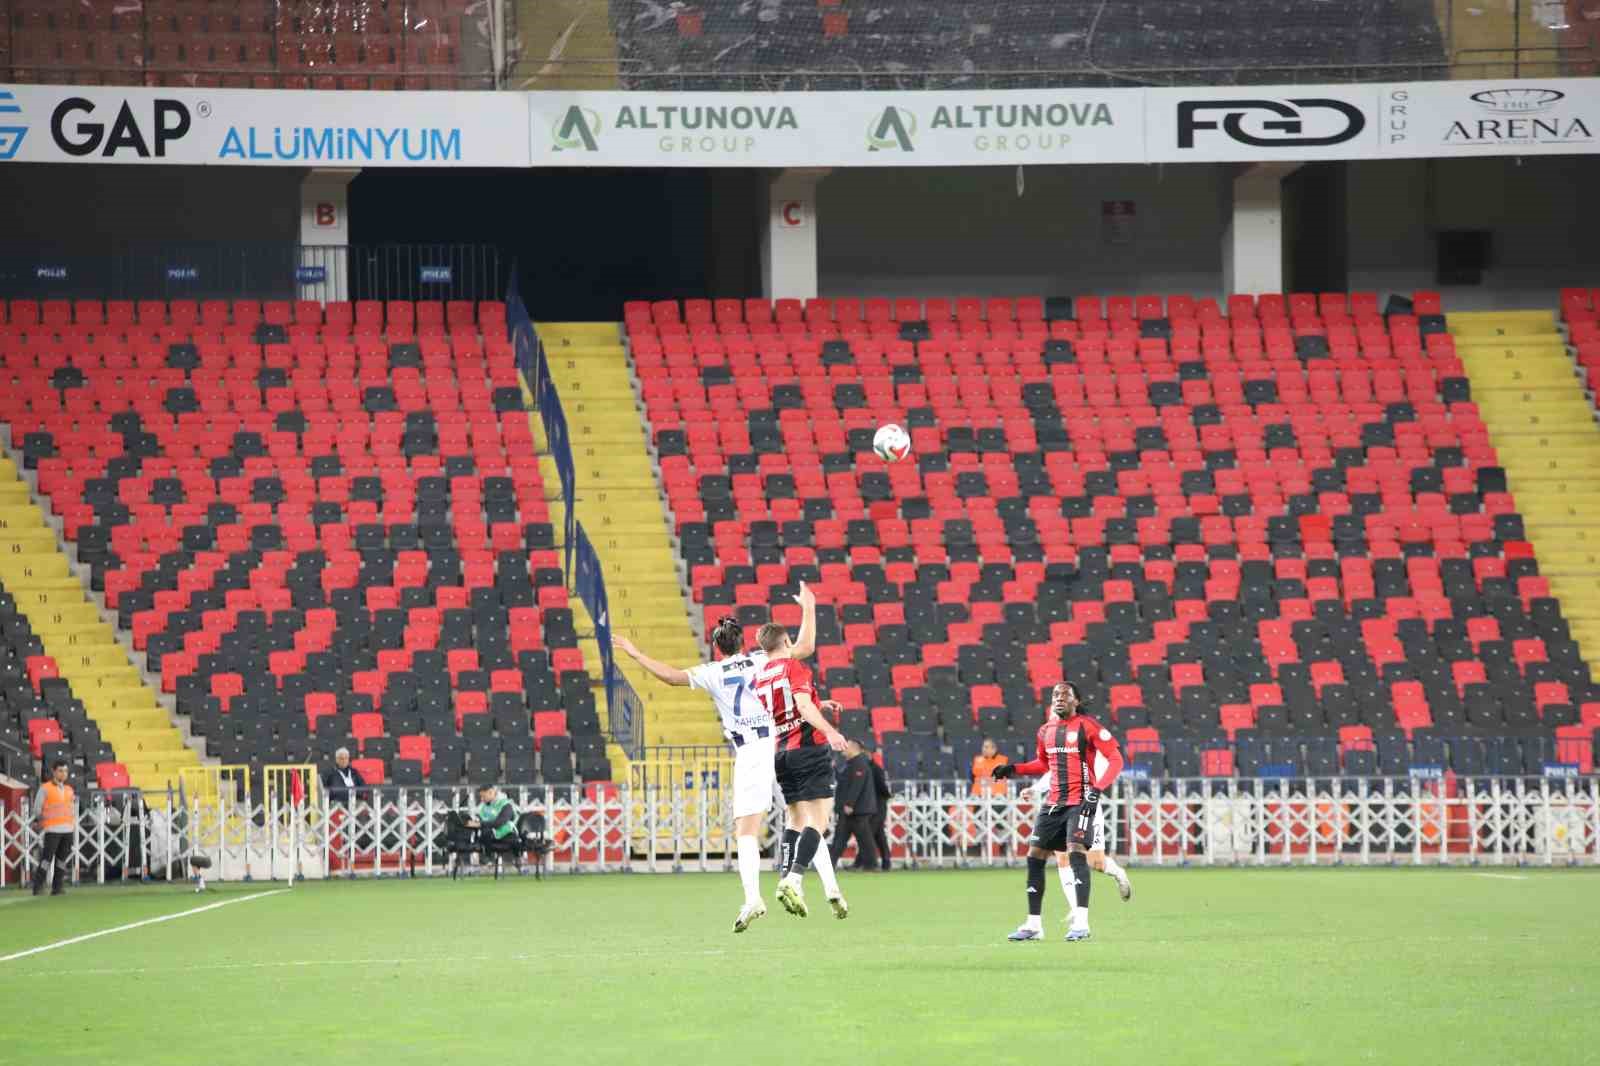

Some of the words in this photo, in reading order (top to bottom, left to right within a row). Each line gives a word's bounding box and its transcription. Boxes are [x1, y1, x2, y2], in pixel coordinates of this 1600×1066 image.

[616, 106, 797, 129] ALTUNOVA
[931, 103, 1113, 128] ALTUNOVA
[1177, 98, 1366, 149] FGD
[51, 97, 191, 158] GAP
[1444, 118, 1593, 141] ARENA
[659, 136, 754, 153] GROUP
[975, 134, 1071, 151] GROUP
[317, 203, 335, 225] B
[785, 203, 802, 225] C
[724, 676, 744, 716] 7
